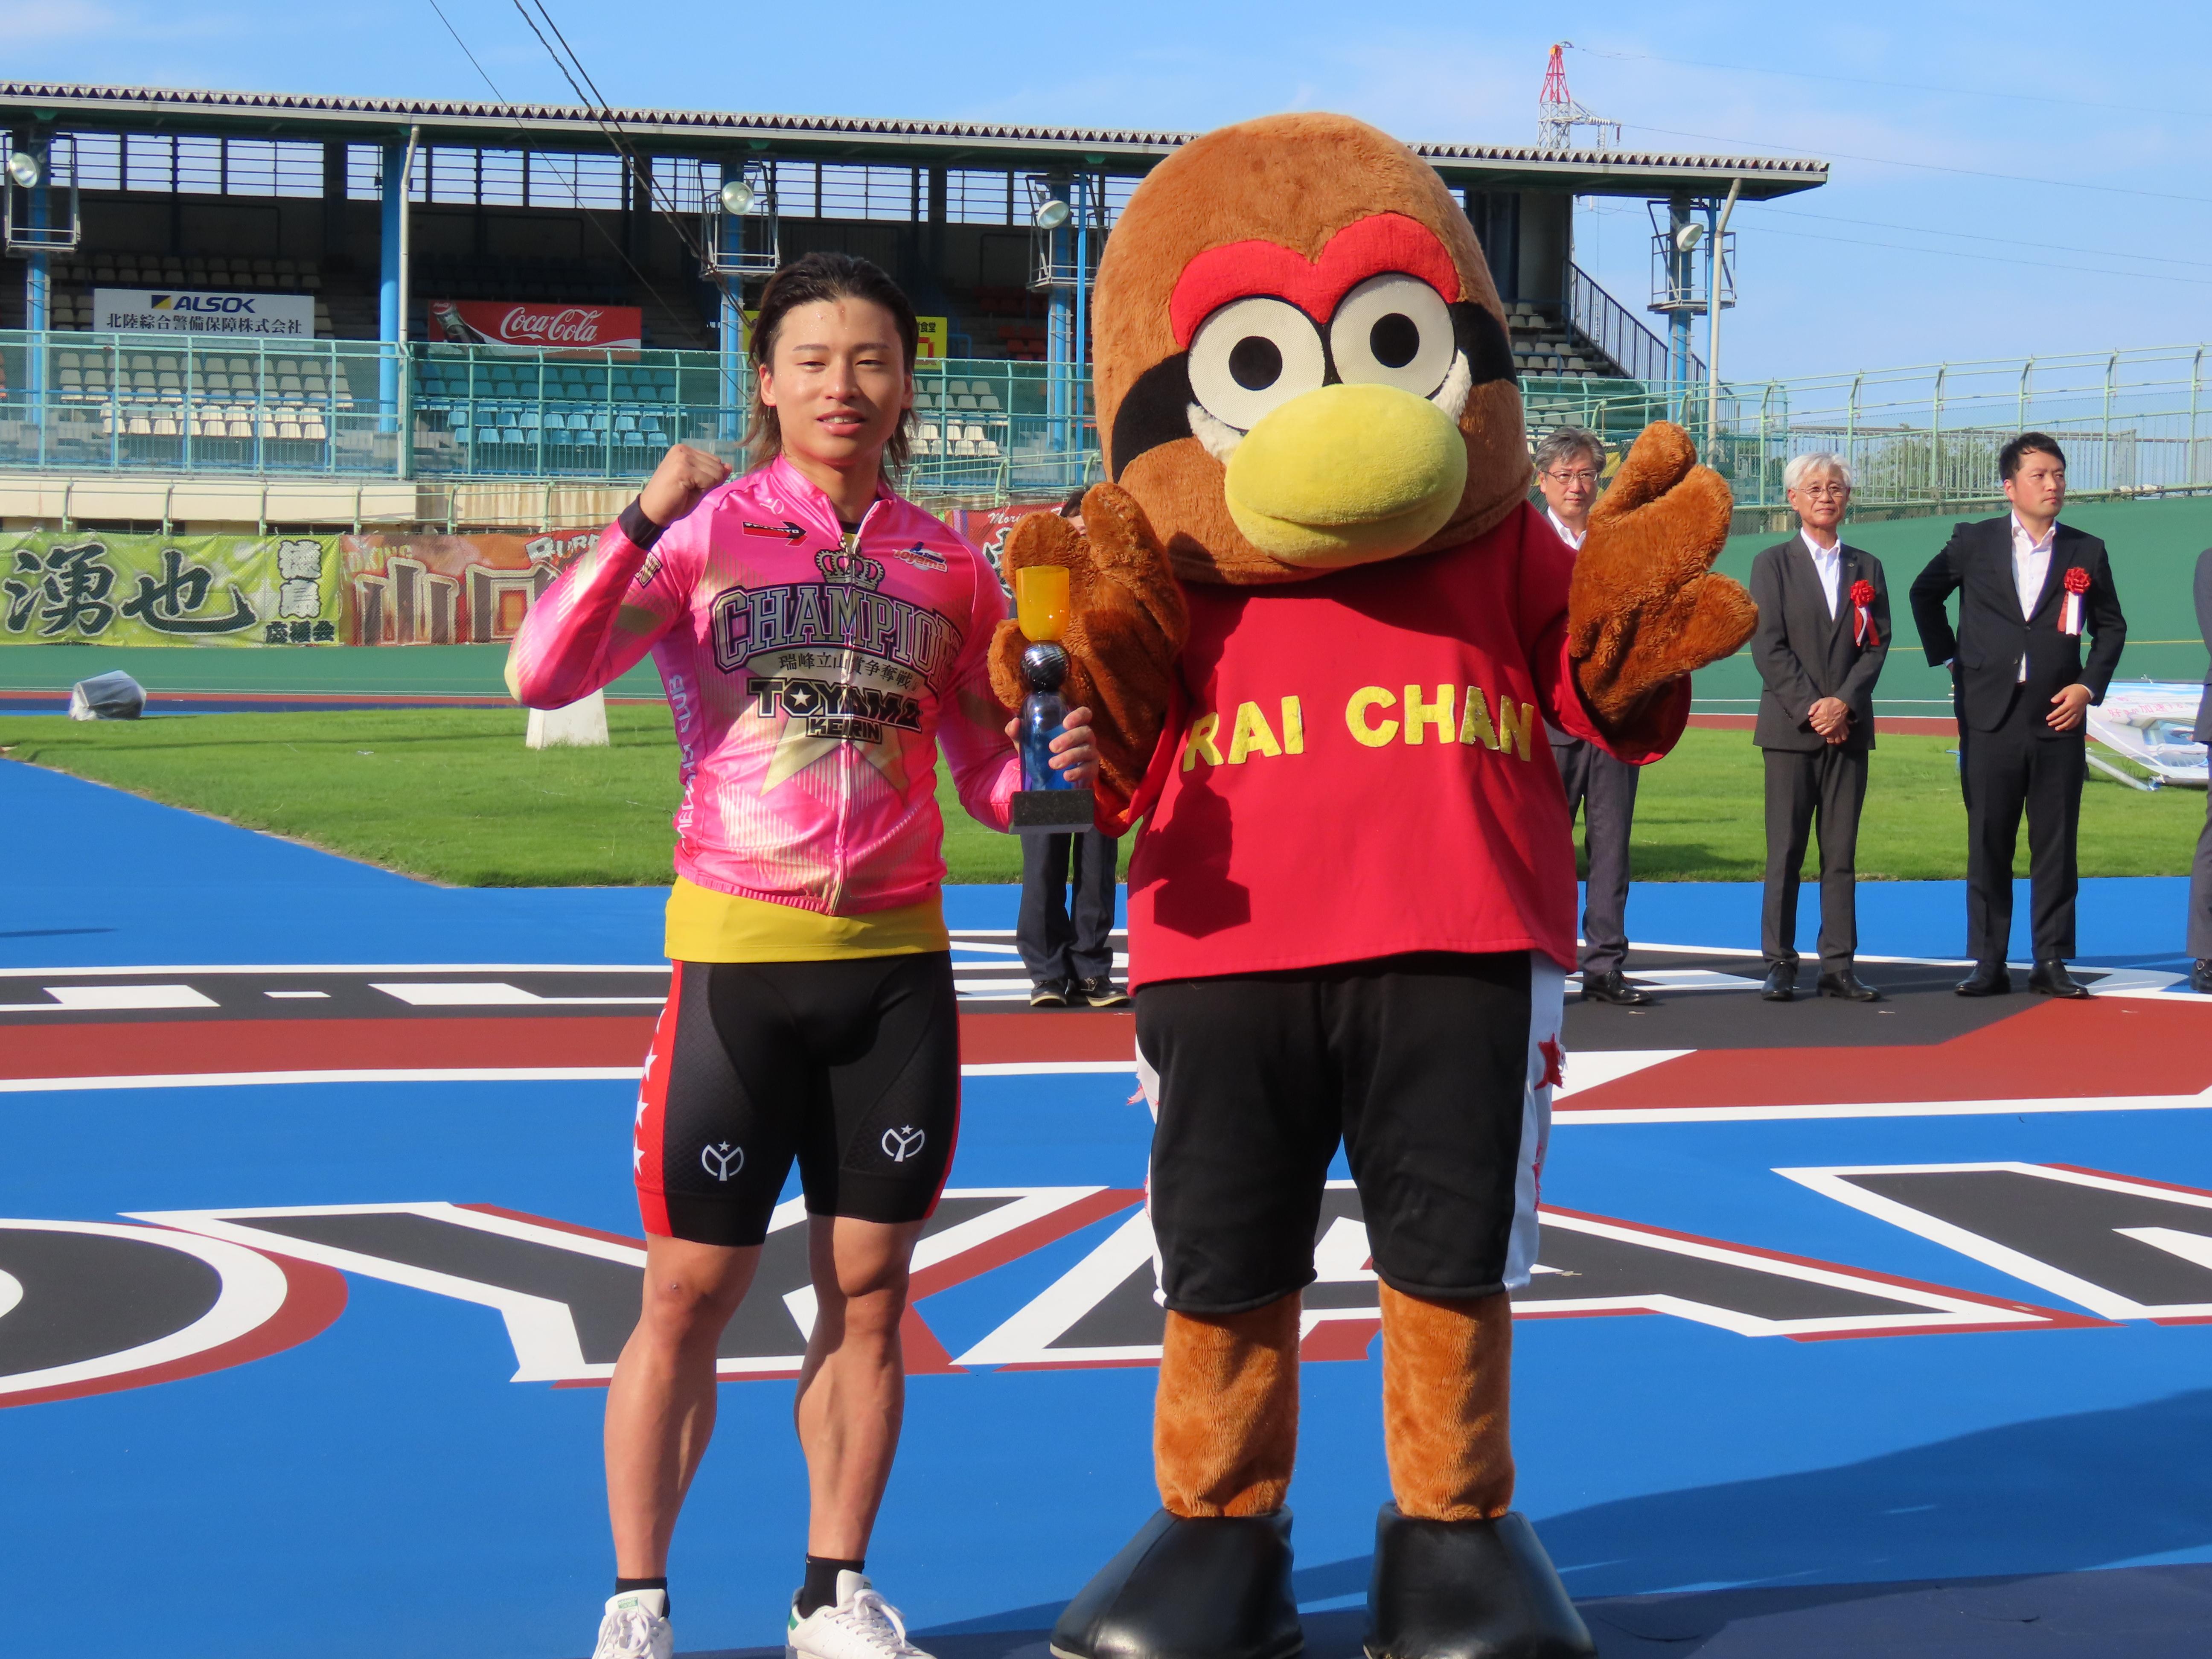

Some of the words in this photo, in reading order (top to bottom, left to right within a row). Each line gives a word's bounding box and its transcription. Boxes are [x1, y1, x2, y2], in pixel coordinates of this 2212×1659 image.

[106, 313, 302, 334] 北陸綜合警備保障株式会社
[173, 296, 256, 314] ALSOK
[500, 306, 603, 342] Coca-Cola
[3, 541, 259, 636] 湧也
[710, 583, 963, 693] CHAMPION
[669, 674, 691, 733] CLUB
[748, 677, 923, 732] TOYAMA
[809, 716, 881, 743] KEIRIN
[1182, 695, 1305, 772] RAI
[1345, 683, 1534, 762] CHAN
